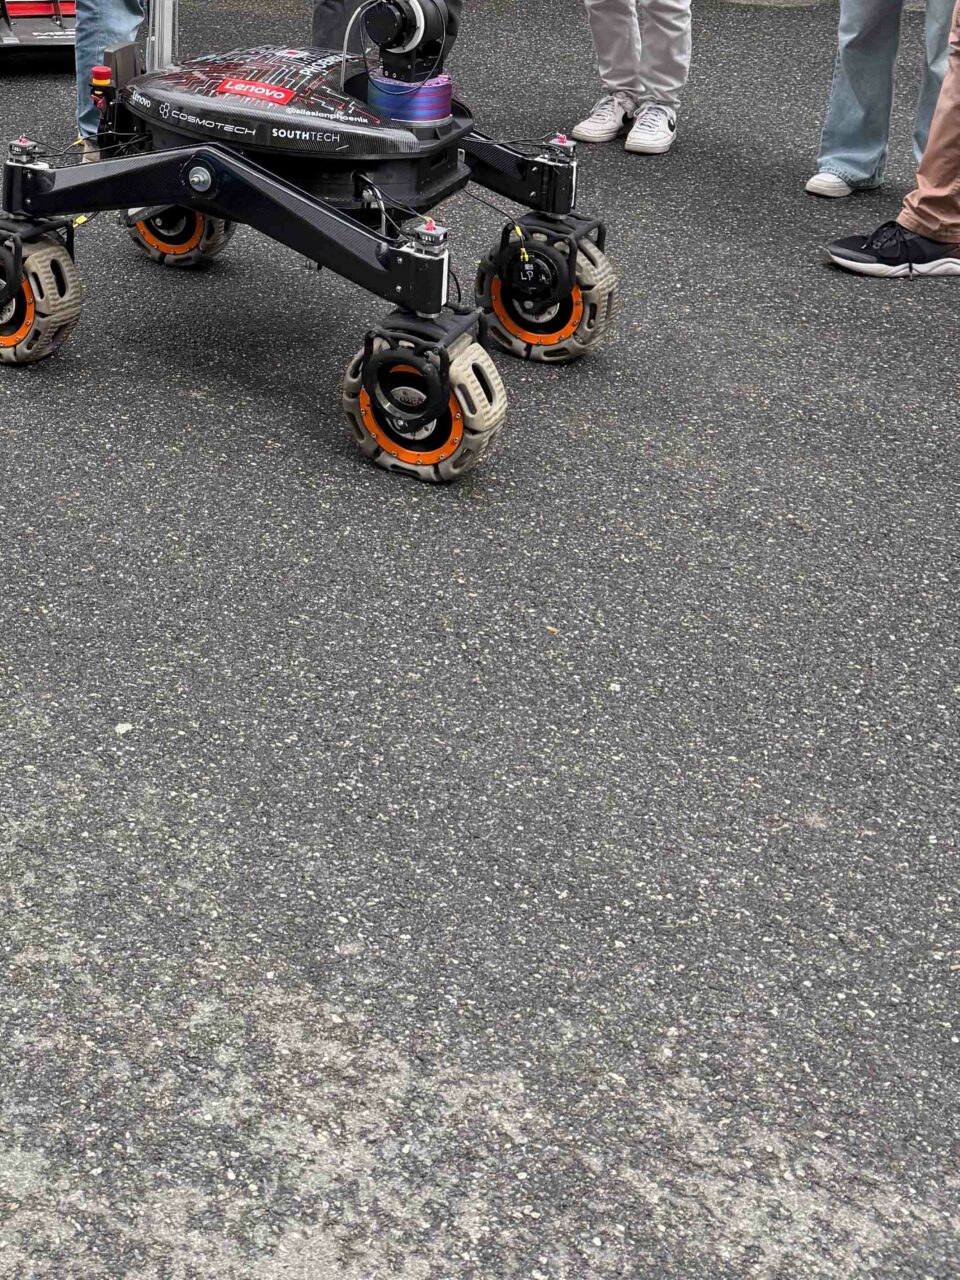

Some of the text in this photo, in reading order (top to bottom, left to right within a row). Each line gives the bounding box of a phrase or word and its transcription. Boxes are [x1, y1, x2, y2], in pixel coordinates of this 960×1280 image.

[132, 90, 151, 108] Lenovo
[224, 81, 286, 99] Lenovo
[171, 110, 257, 136] COSMOTECH
[272, 127, 340, 142] SOUTHTECH
